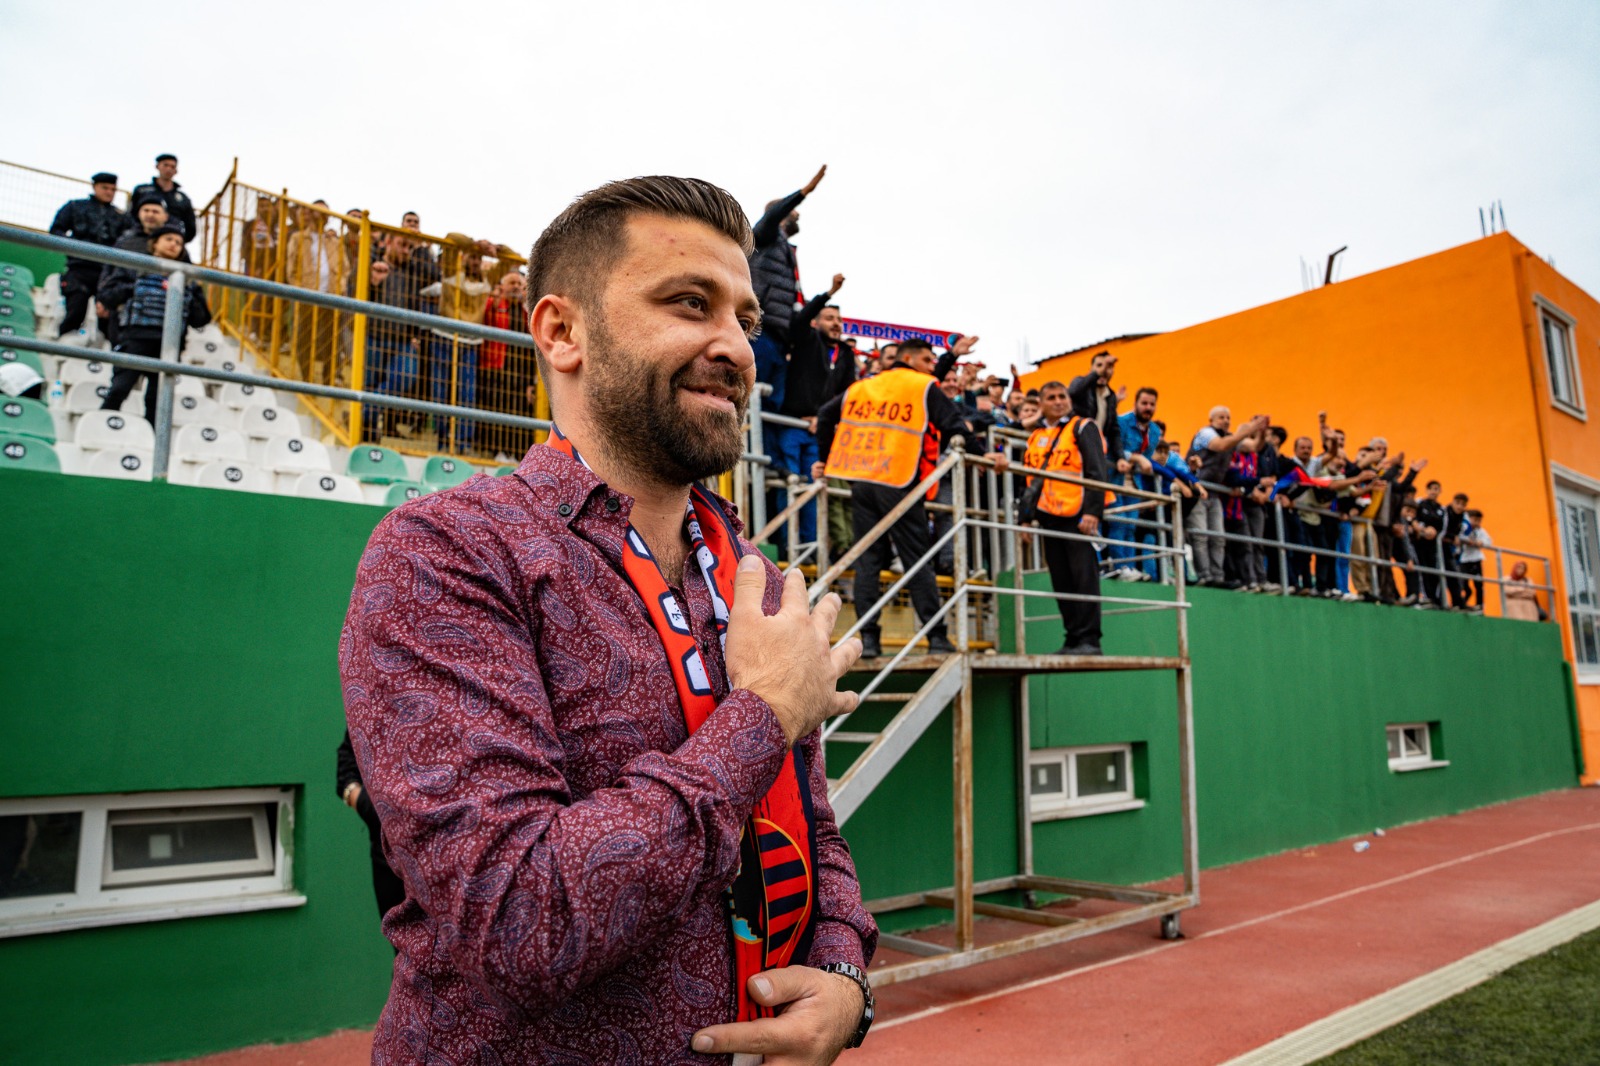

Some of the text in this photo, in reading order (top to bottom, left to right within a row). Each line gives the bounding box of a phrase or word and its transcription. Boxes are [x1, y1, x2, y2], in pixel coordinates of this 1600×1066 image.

[4, 444, 25, 458] 48
[225, 468, 241, 481] 50
[321, 478, 335, 490] 51
